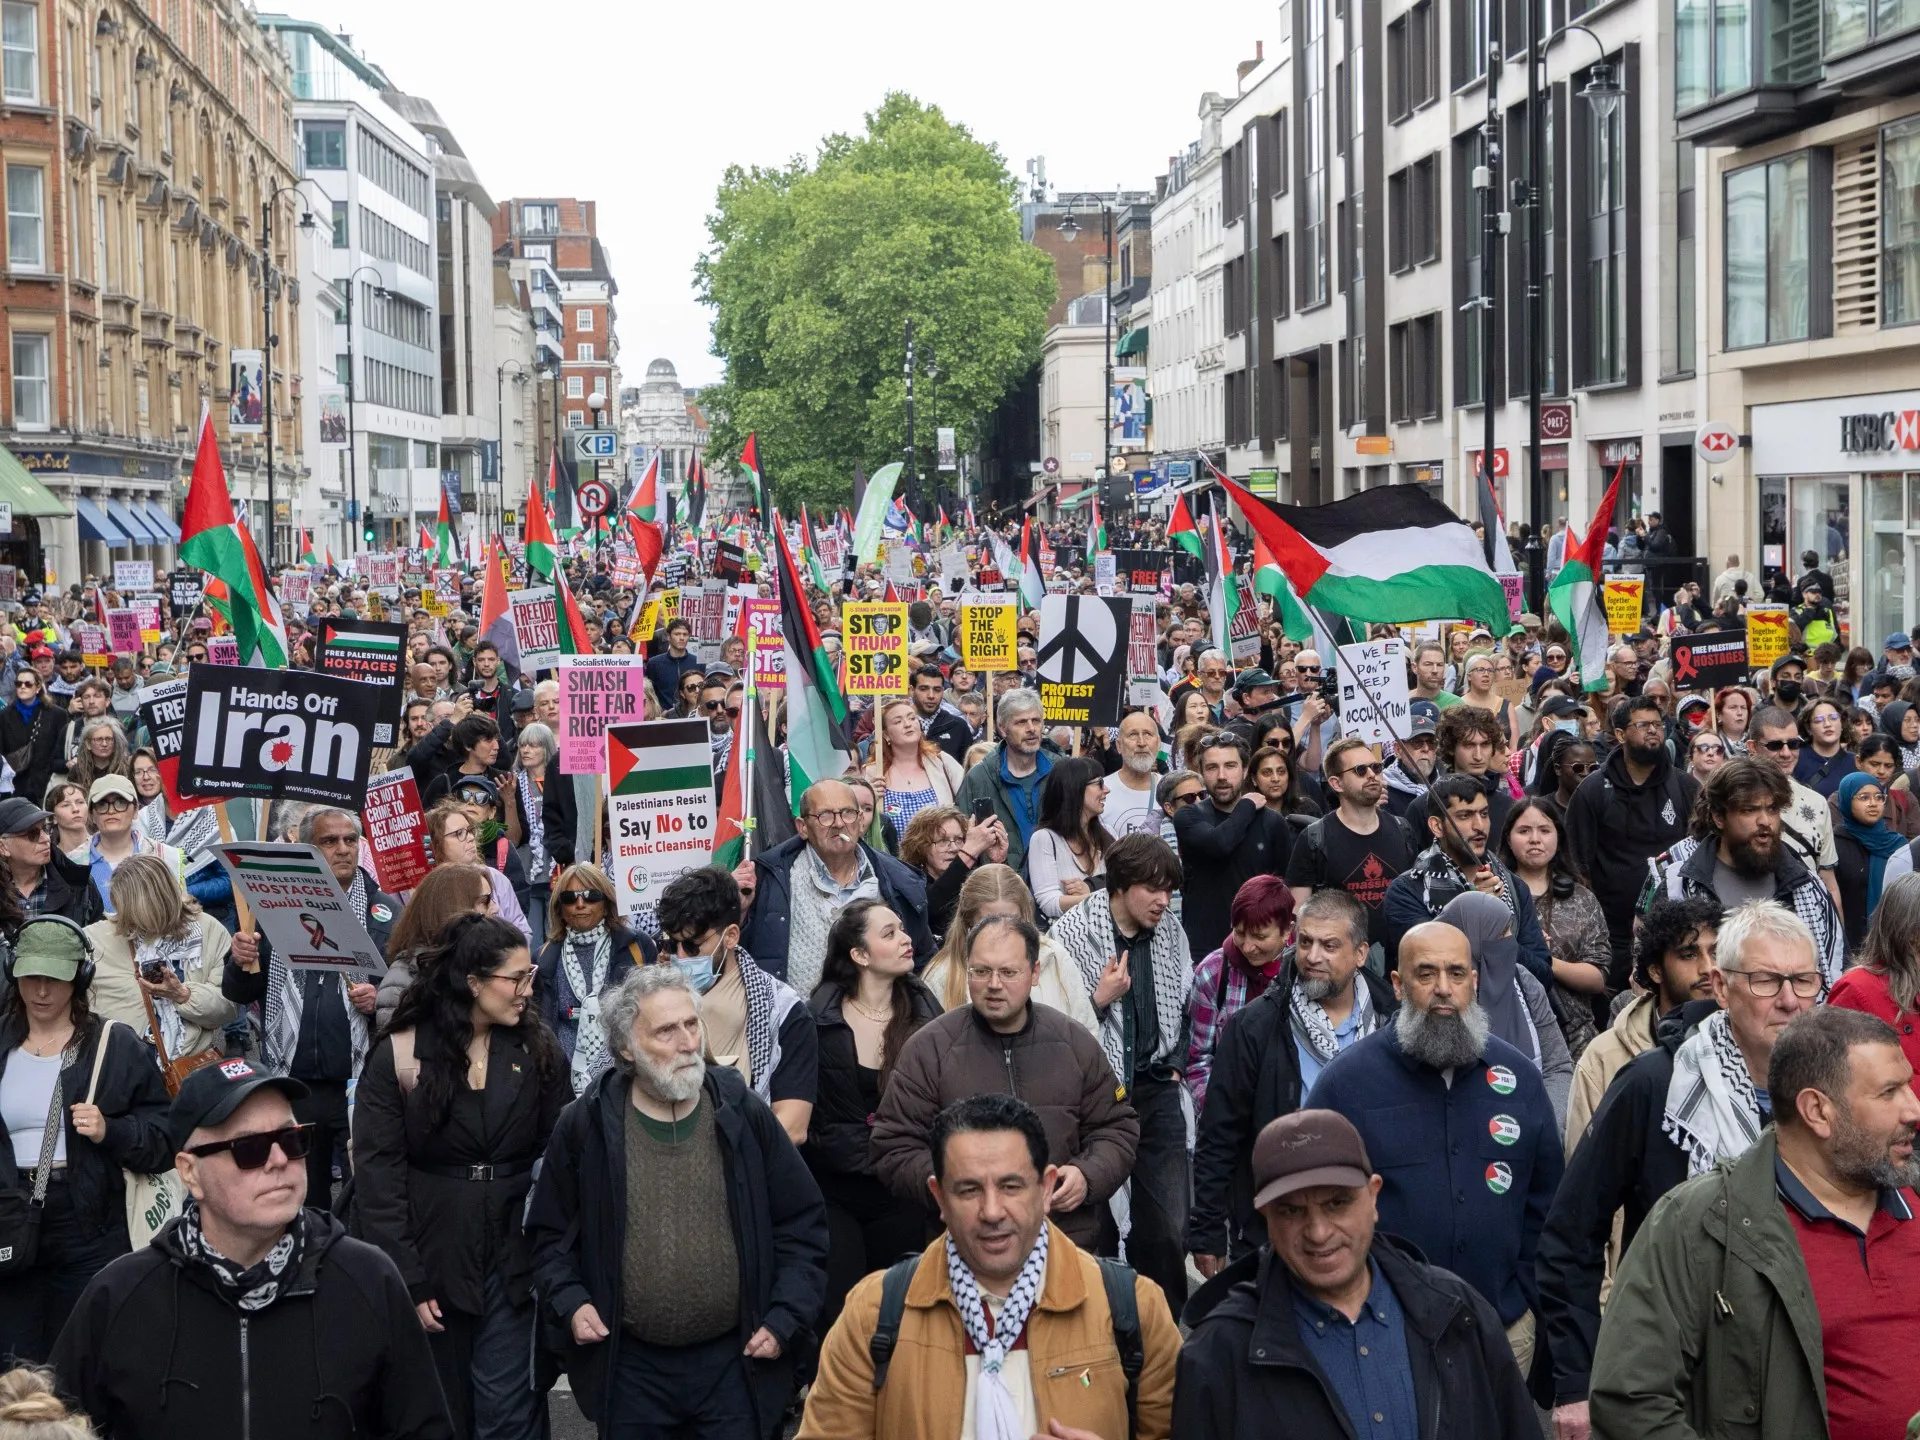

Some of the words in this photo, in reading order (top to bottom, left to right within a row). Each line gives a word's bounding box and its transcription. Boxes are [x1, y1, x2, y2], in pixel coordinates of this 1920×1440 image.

[1547, 416, 1563, 428] PRET
[1840, 412, 1896, 452] HSBC
[1132, 571, 1157, 584] FREE
[174, 582, 199, 590] STOP
[1608, 596, 1629, 605] Together
[513, 600, 557, 626] FREEDO
[970, 607, 1003, 618] STOP
[1626, 604, 1637, 612] stop
[1625, 611, 1637, 620] right
[970, 620, 994, 631] THE
[1752, 627, 1777, 636] Together
[517, 623, 559, 649] PALESTI
[970, 632, 993, 643] FAR
[850, 636, 901, 650] TRUMP
[1692, 646, 1707, 654] FREE
[1708, 641, 1744, 652] PALESTINIAN
[347, 651, 398, 661] PALESTINIAN
[970, 645, 1009, 656] RIGHT
[1362, 647, 1381, 660] WE
[324, 657, 397, 673] HOSTAGES
[572, 658, 631, 667] SocialistWorker
[1693, 651, 1745, 667] HOSTAGES
[1357, 661, 1391, 674] DON'T
[568, 671, 627, 691] SMASH
[850, 675, 902, 689] FARAGE
[1041, 684, 1094, 697] PROTEST
[229, 686, 298, 711] Hands
[303, 693, 339, 716] Off
[568, 694, 600, 714] THE
[605, 694, 635, 714] FAR
[1041, 696, 1066, 708] AND
[1426, 707, 1433, 717] R
[569, 716, 620, 737] RIGHT
[194, 691, 360, 782] Iran
[204, 779, 219, 788] Stop
[231, 780, 244, 788] War
[245, 781, 273, 790] coalition
[369, 773, 404, 788] ocialistWorker
[285, 785, 352, 801] www.stopwar.org.uk
[381, 785, 397, 800] NOT
[398, 784, 404, 798] A
[616, 797, 674, 812] Palestinians
[676, 794, 707, 806] Resist
[366, 803, 392, 823] CRIME
[393, 800, 404, 816] TO
[370, 819, 388, 838] ACT
[388, 811, 420, 833] AGAINST
[620, 818, 651, 840] Say
[656, 814, 683, 834] No
[688, 813, 708, 830] to
[374, 829, 414, 852] GENOCIDE
[620, 843, 653, 857] Ethnic
[656, 837, 712, 853] Cleansing
[240, 873, 264, 881] FREE
[266, 876, 328, 885] PALESTINIAN
[1347, 879, 1392, 890] massiv
[246, 882, 334, 898] HOSTAGES
[1354, 893, 1384, 901] attac
